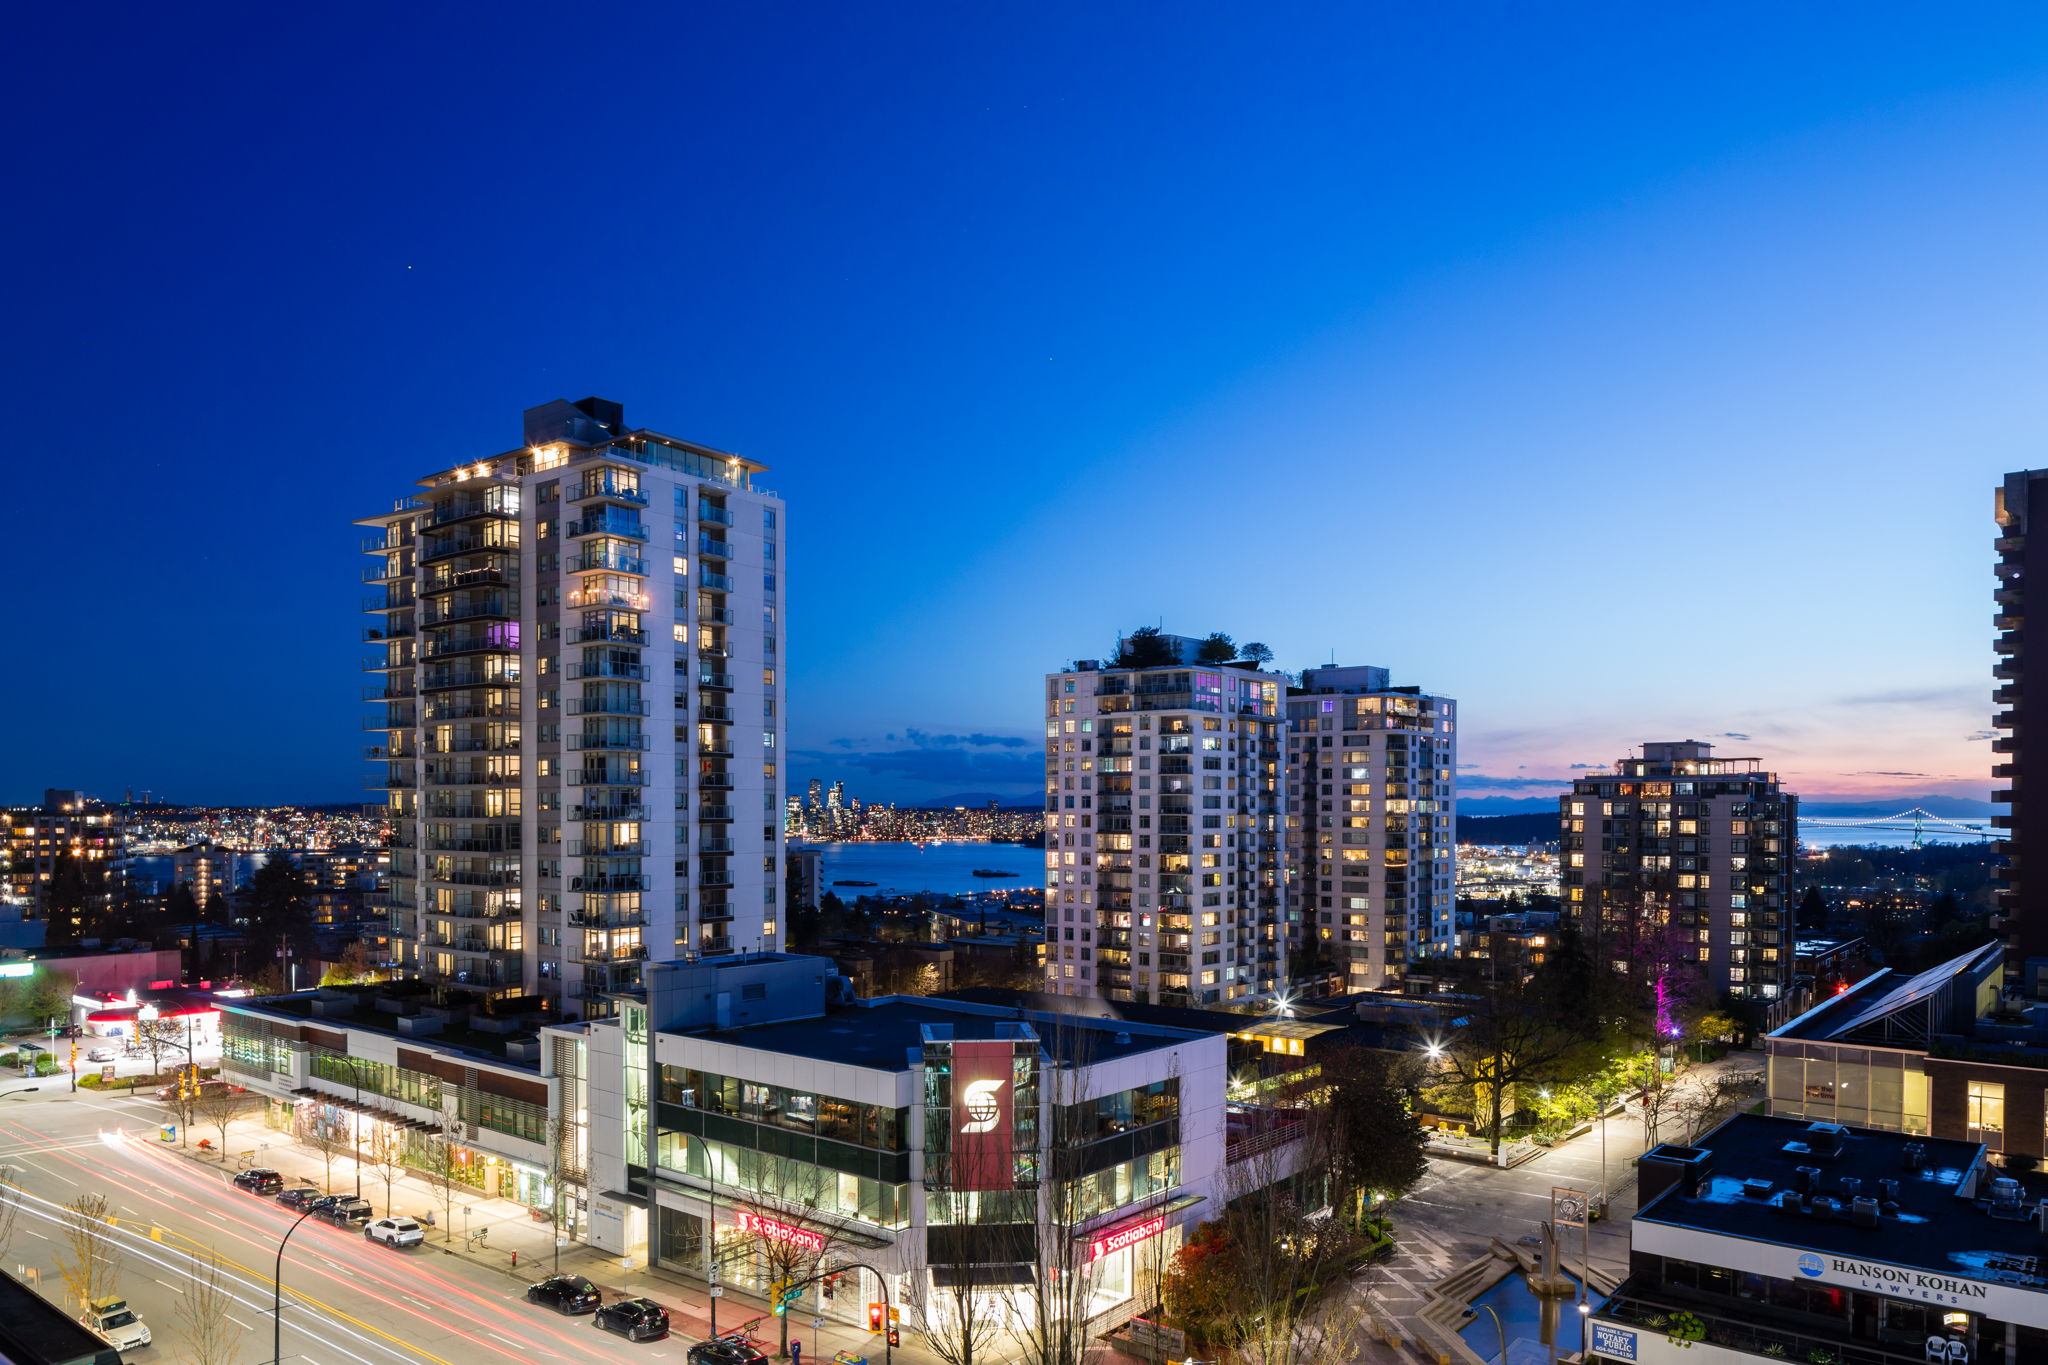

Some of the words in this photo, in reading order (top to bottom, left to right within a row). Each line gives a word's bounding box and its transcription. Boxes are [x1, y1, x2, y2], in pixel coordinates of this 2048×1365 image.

[752, 1216, 821, 1249] Scotiabank
[1107, 1217, 1164, 1251] Scotiabank
[1832, 1259, 1910, 1284] HANSON
[1916, 1274, 1988, 1299] KOHAN
[1862, 1280, 1958, 1304] LAWYERS
[1597, 1331, 1629, 1345] NOTARY
[1604, 1339, 1632, 1353] PUBLIC
